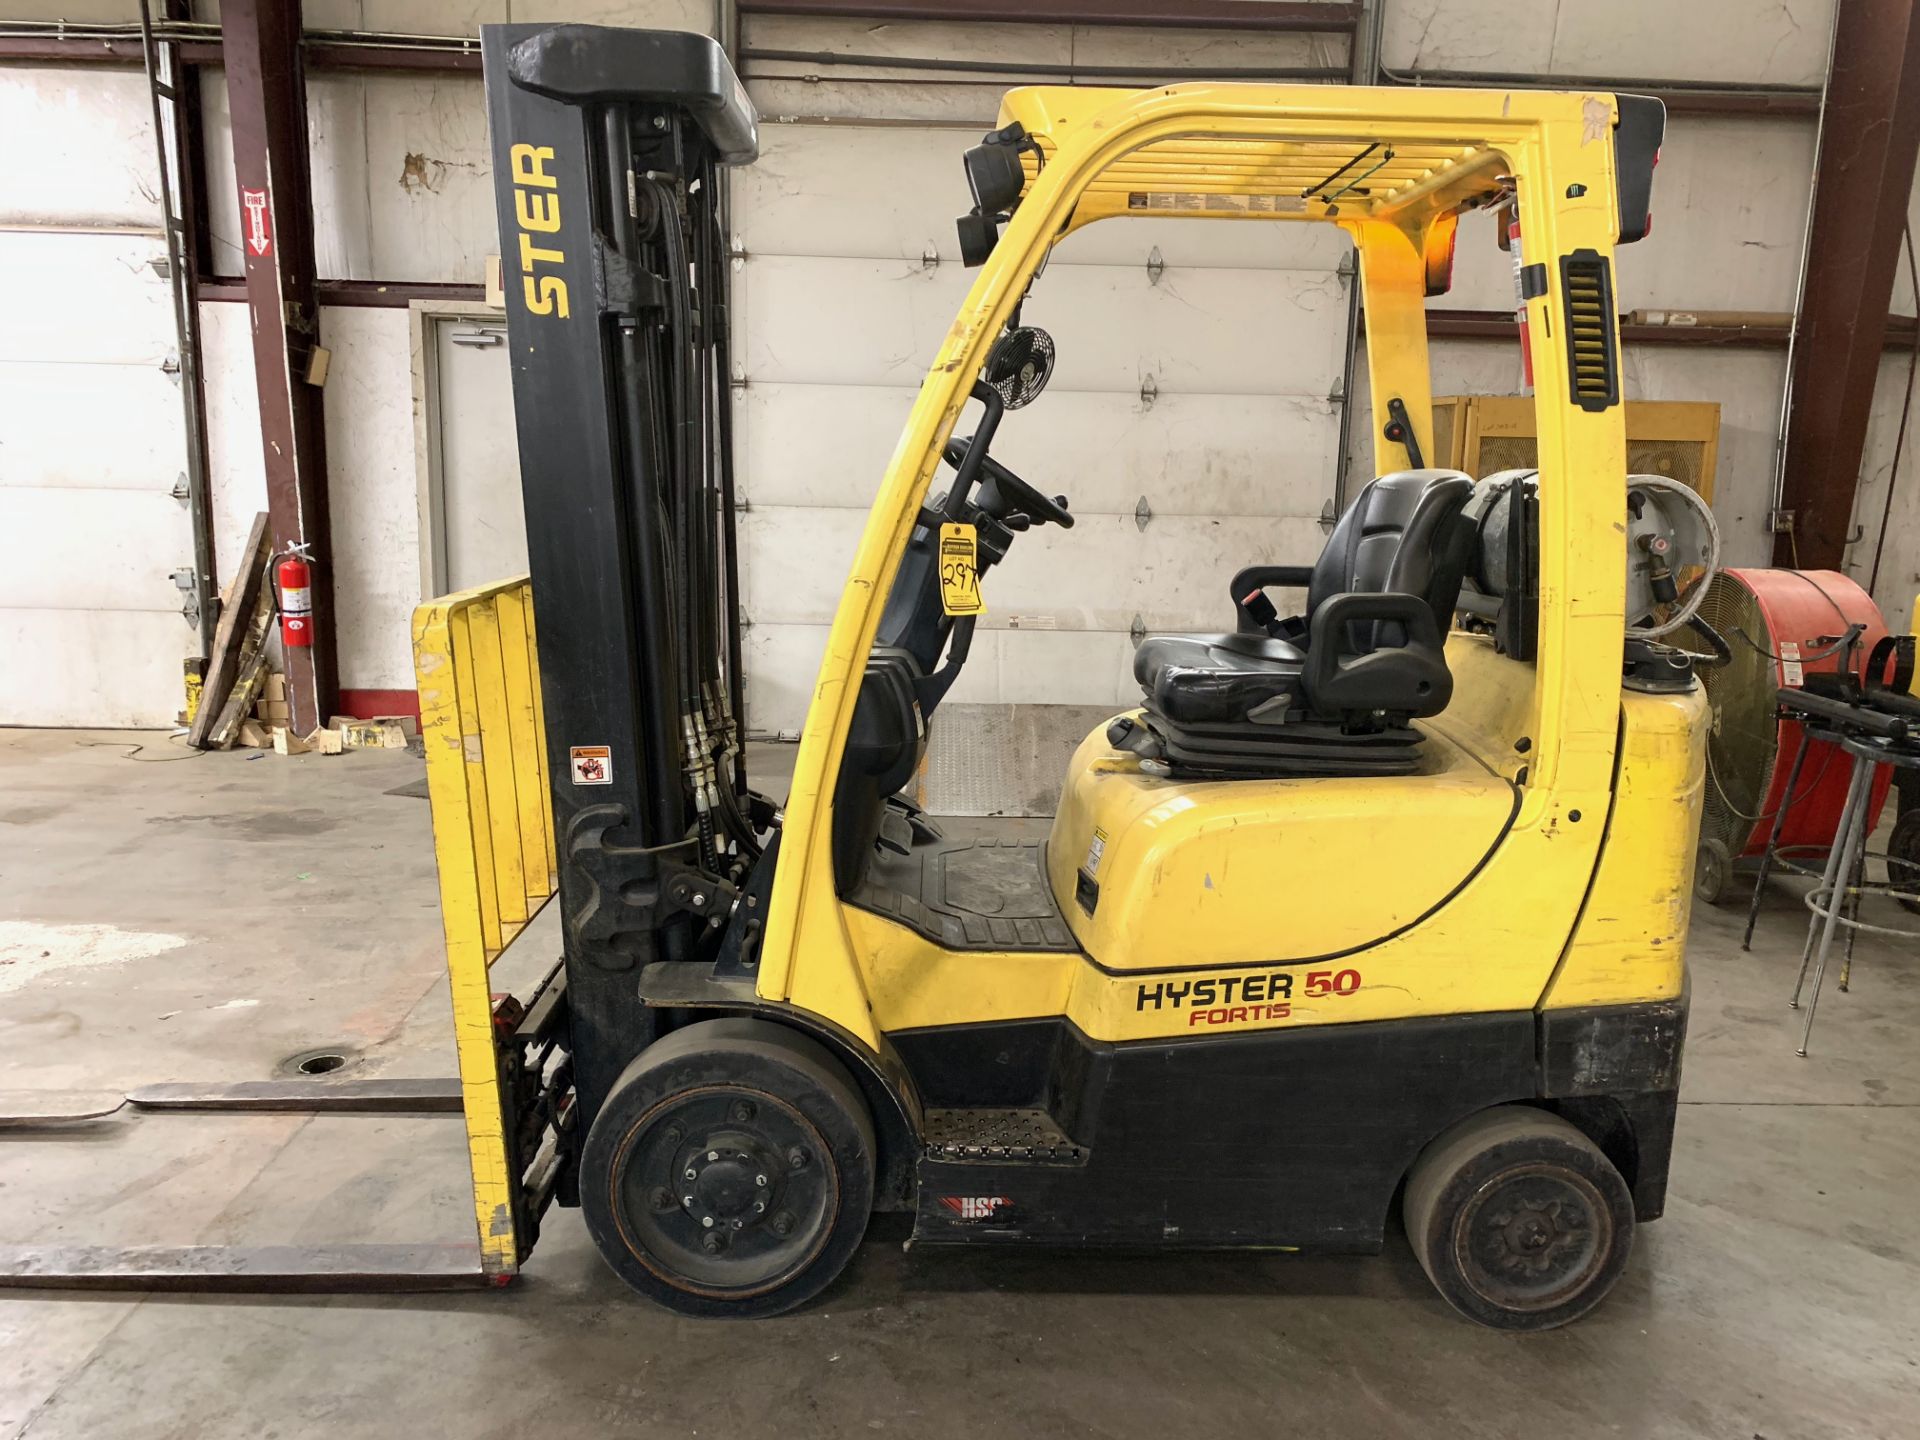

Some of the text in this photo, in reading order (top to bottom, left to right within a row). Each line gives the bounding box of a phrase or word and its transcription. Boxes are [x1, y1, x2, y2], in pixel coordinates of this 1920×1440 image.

[246, 195, 264, 206] FIRE
[510, 143, 570, 319] STER
[943, 563, 978, 592] 297
[1136, 969, 1362, 1011] HYSTER 50
[1189, 1003, 1291, 1026] FORTIS
